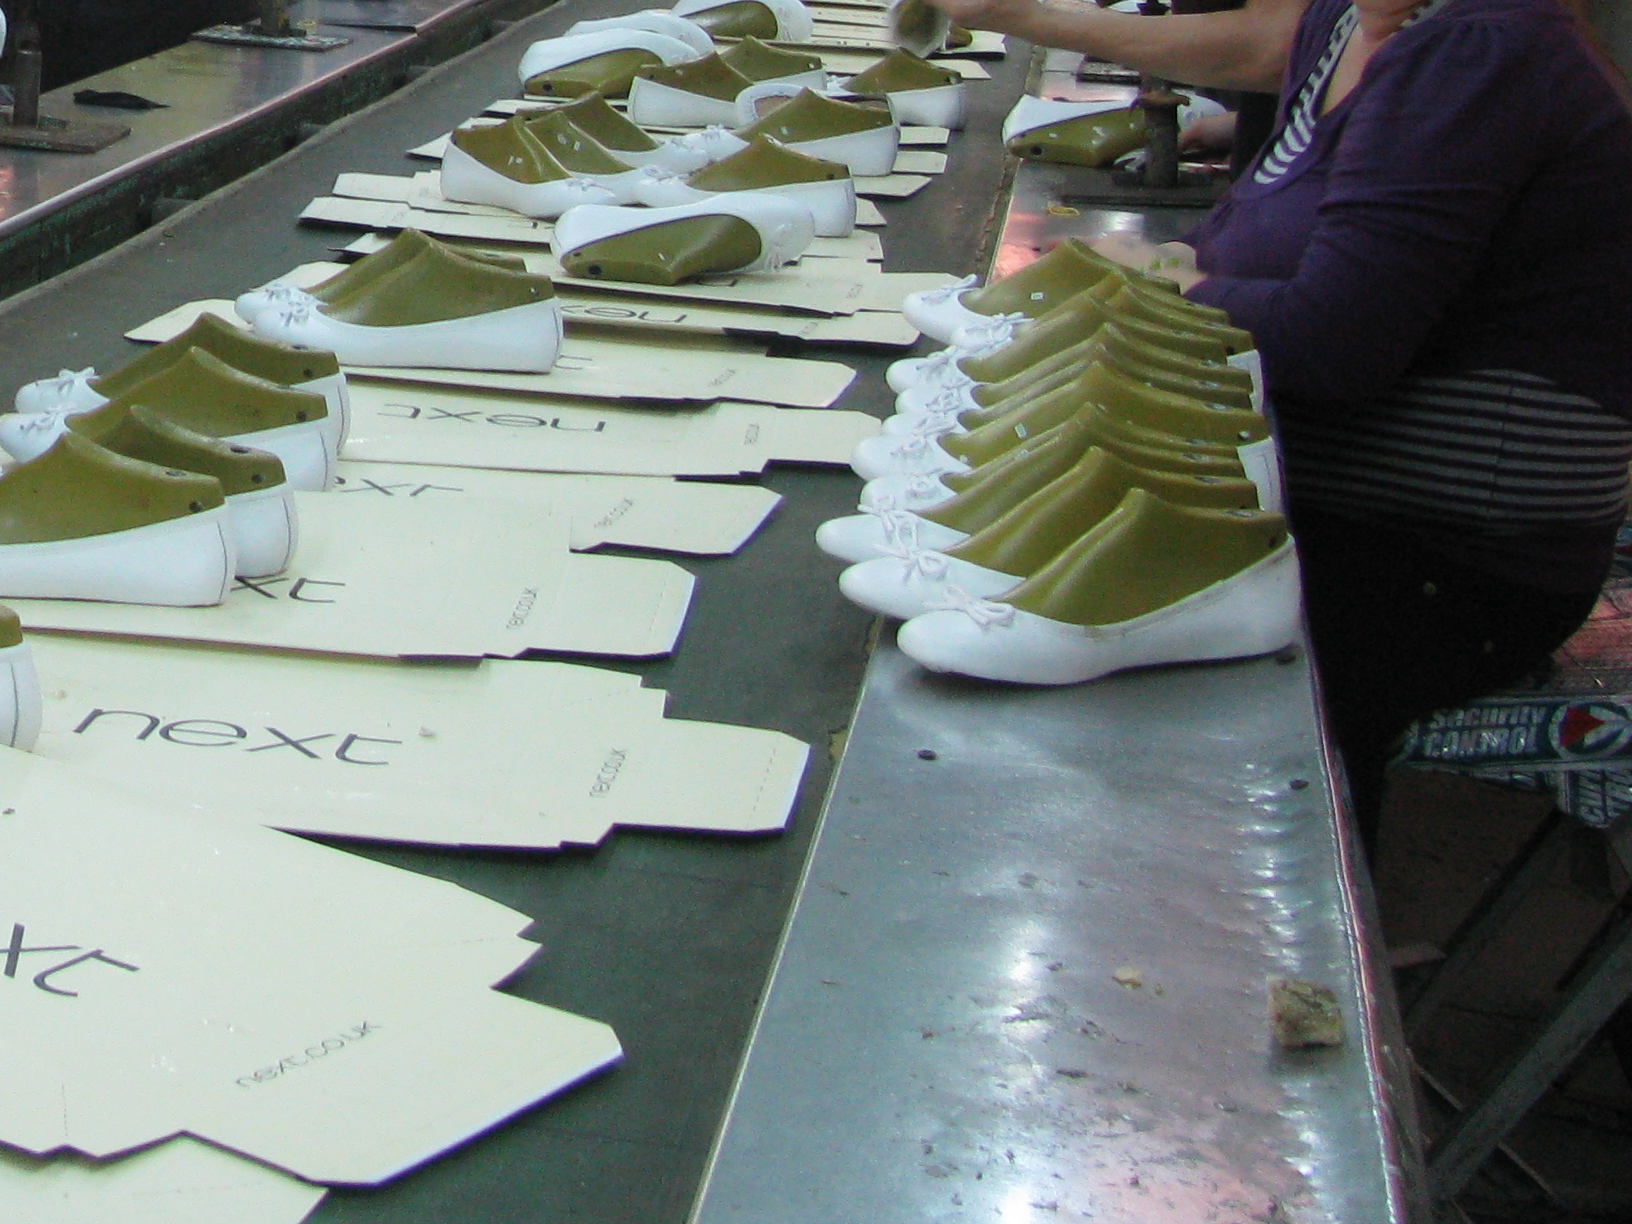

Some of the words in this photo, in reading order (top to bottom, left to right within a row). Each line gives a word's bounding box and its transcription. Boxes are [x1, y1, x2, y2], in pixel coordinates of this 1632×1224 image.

[376, 402, 607, 432] next
[229, 576, 347, 604] xt
[72, 708, 404, 766] next
[235, 1020, 382, 1090] next.co.uk
